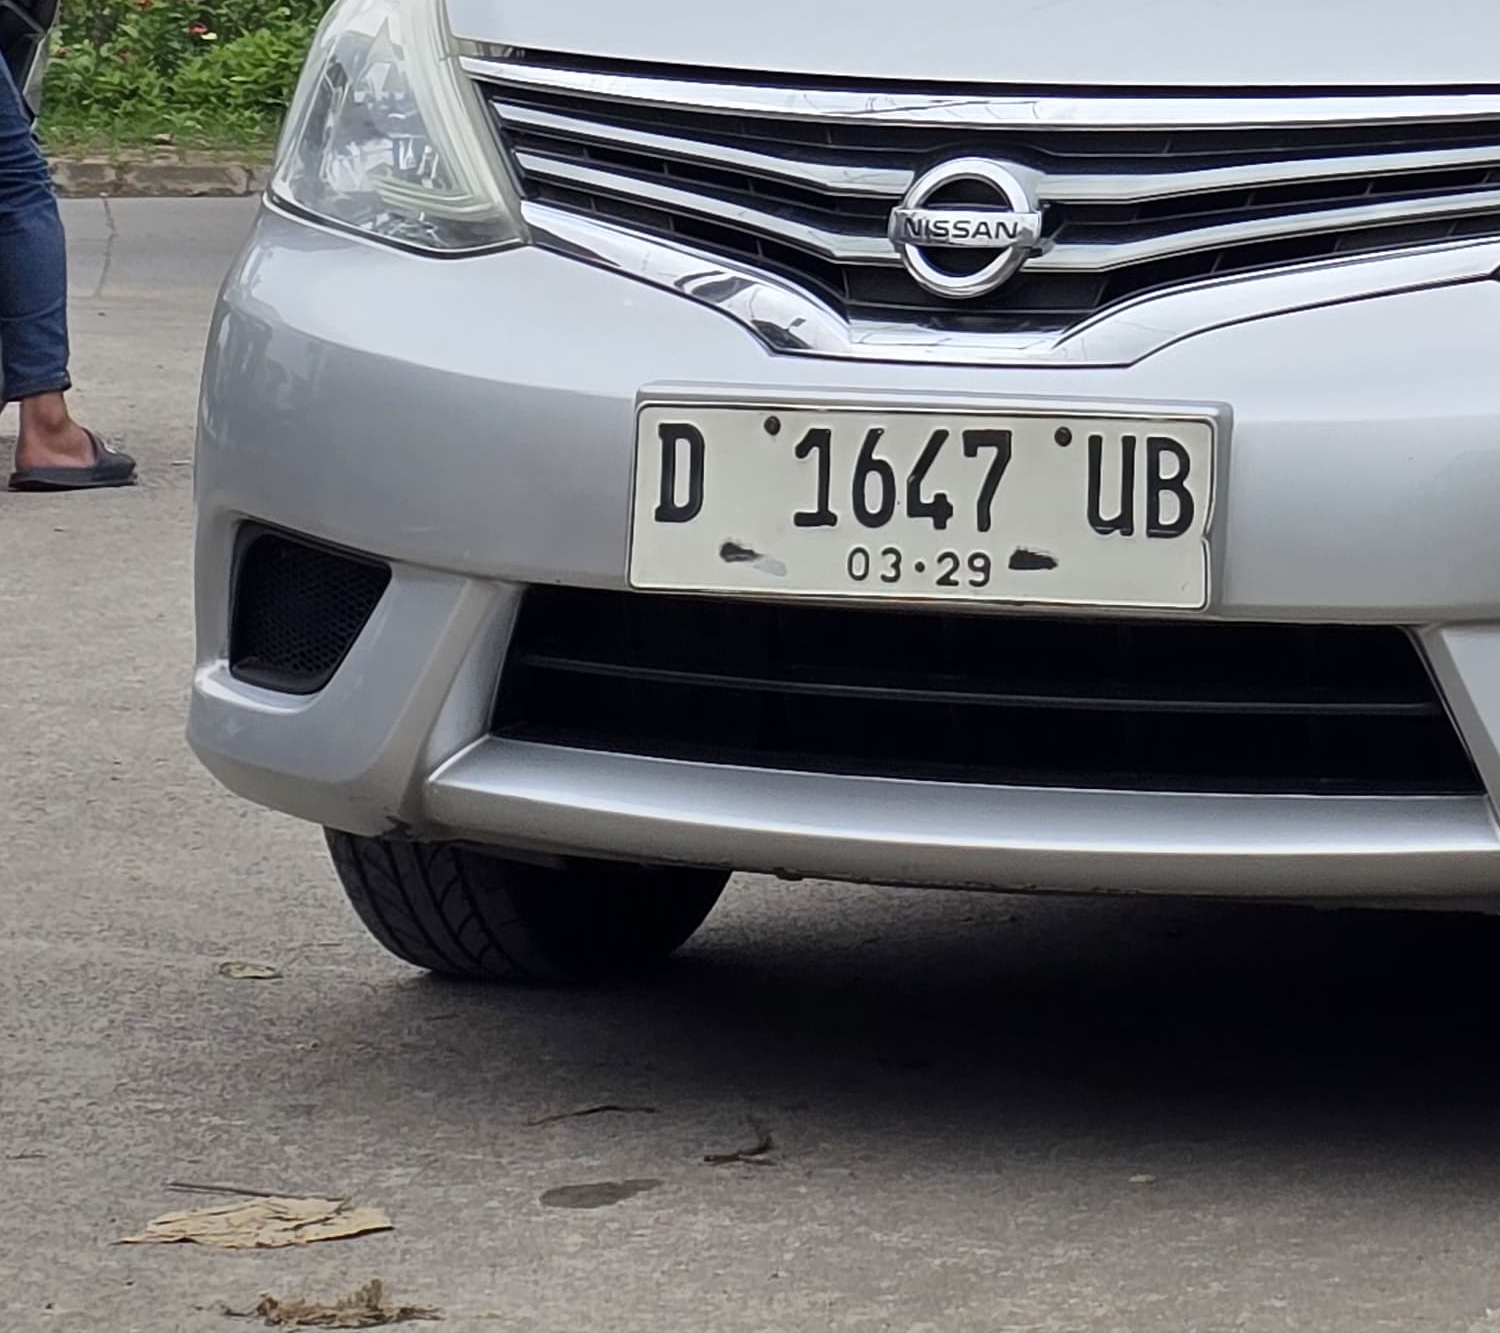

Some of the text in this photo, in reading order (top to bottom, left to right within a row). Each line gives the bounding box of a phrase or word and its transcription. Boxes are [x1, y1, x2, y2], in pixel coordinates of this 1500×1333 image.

[904, 217, 1018, 239] NISSAN
[654, 422, 1195, 539] D 1647 UB
